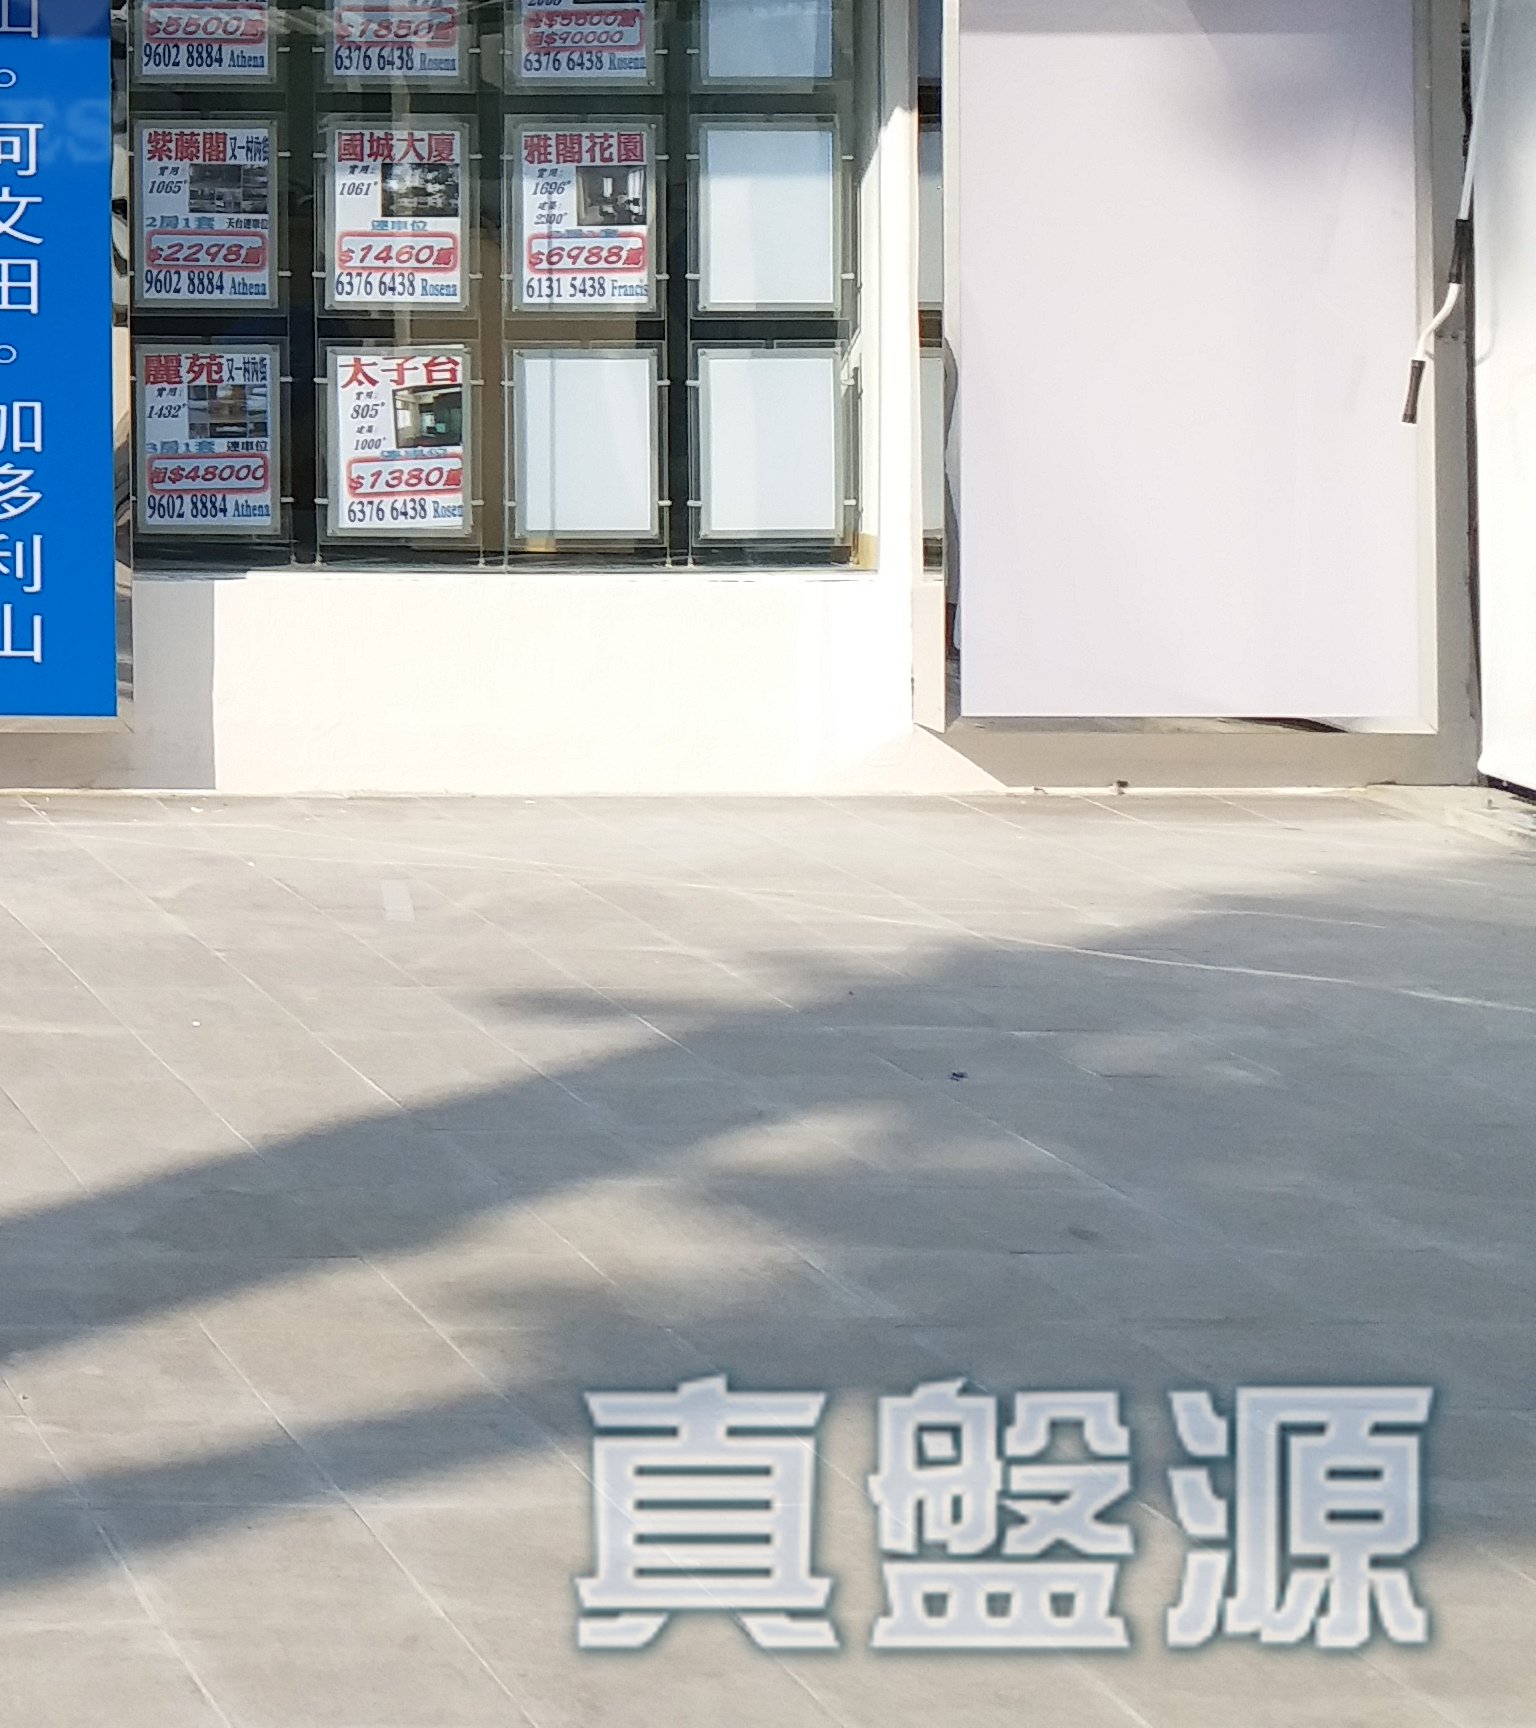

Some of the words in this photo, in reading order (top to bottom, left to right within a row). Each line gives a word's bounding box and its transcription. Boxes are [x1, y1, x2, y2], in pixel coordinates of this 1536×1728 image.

[144, 43, 180, 67] 9602
[186, 43, 223, 67] 8884
[228, 49, 265, 68] Athena
[335, 46, 372, 70] 6376
[378, 46, 414, 70] 6438
[523, 51, 562, 71] 6376
[566, 51, 604, 71] 6438
[147, 131, 227, 161] 紫藤閣
[337, 132, 455, 162] 國城大廈
[145, 269, 182, 294] 9602
[187, 269, 224, 294] 8884
[229, 277, 266, 295] Athena
[336, 272, 373, 296] 6376
[379, 272, 416, 296] 6438
[420, 278, 458, 296] Rosena
[526, 276, 562, 298] 6131
[569, 276, 606, 298] 5438
[145, 353, 224, 384] 麗苑
[339, 356, 460, 389] 太子台
[147, 494, 185, 519] 9602
[190, 493, 228, 518] 8884
[232, 499, 270, 517] Athena
[347, 500, 385, 522] 6376
[390, 497, 427, 521] 6438
